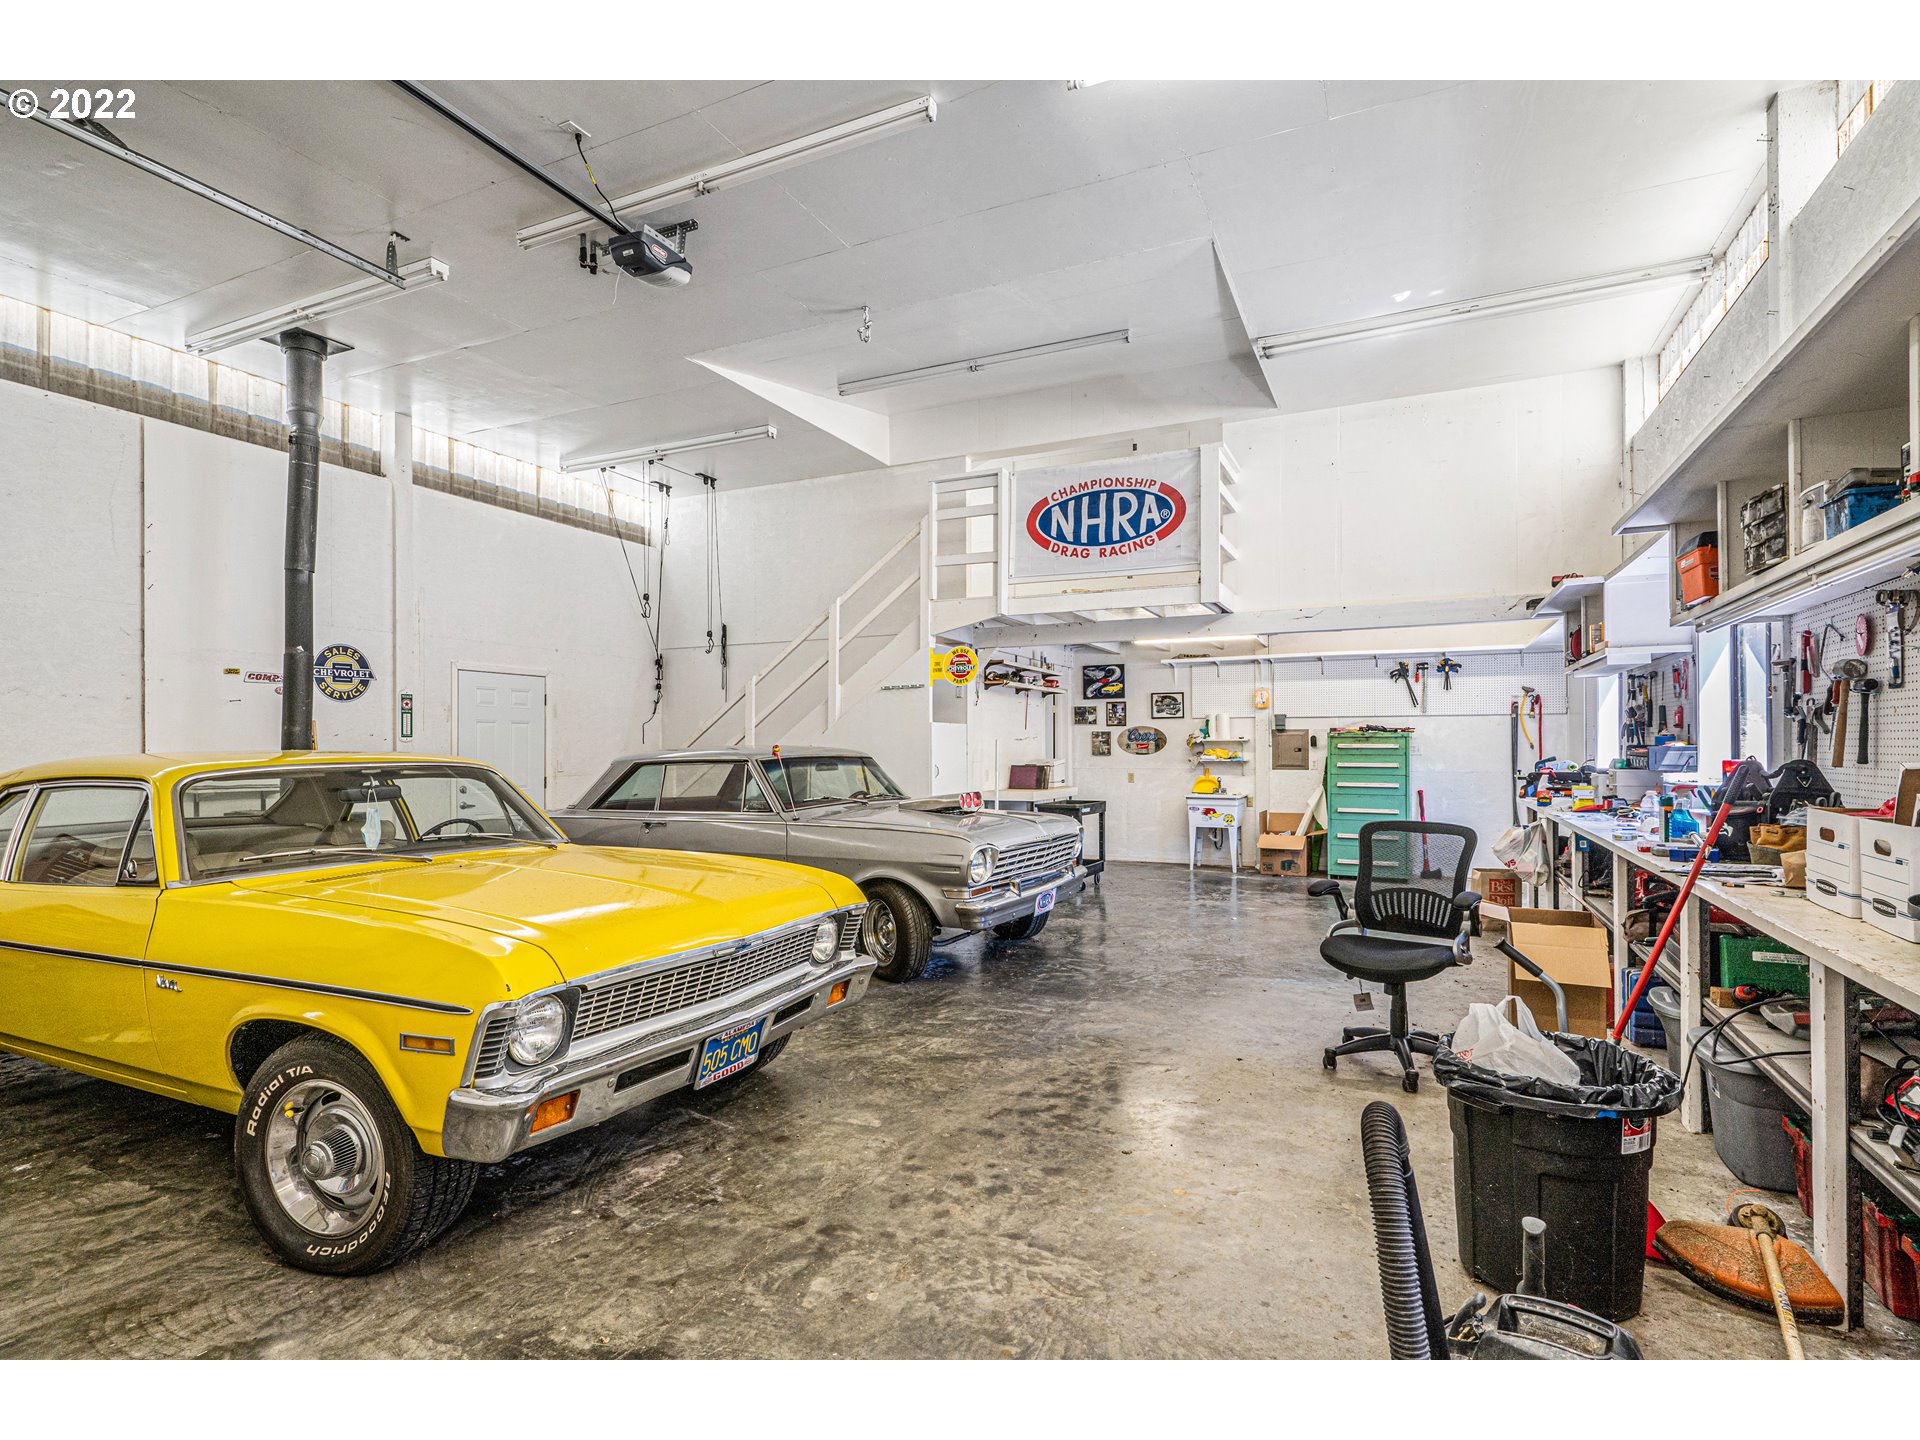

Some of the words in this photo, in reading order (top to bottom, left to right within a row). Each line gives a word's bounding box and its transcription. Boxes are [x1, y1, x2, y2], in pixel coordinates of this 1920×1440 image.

[1051, 477, 1157, 502] CHAMPIONSHIP
[1050, 491, 1162, 543] NHRA
[1051, 542, 1090, 559] DRAG
[1099, 535, 1156, 559] RACING
[323, 646, 361, 660] SALES
[247, 673, 280, 682] COMP
[313, 668, 370, 678] CHEVROLET
[319, 681, 366, 700] SERVICE
[1490, 880, 1514, 893] Best
[724, 1020, 755, 1037] ALAMEDA
[702, 1044, 729, 1075] 505
[730, 1031, 758, 1061] CMO
[713, 1060, 744, 1081] GOOD
[246, 1074, 284, 1137] Radial
[285, 1065, 314, 1078] T/A
